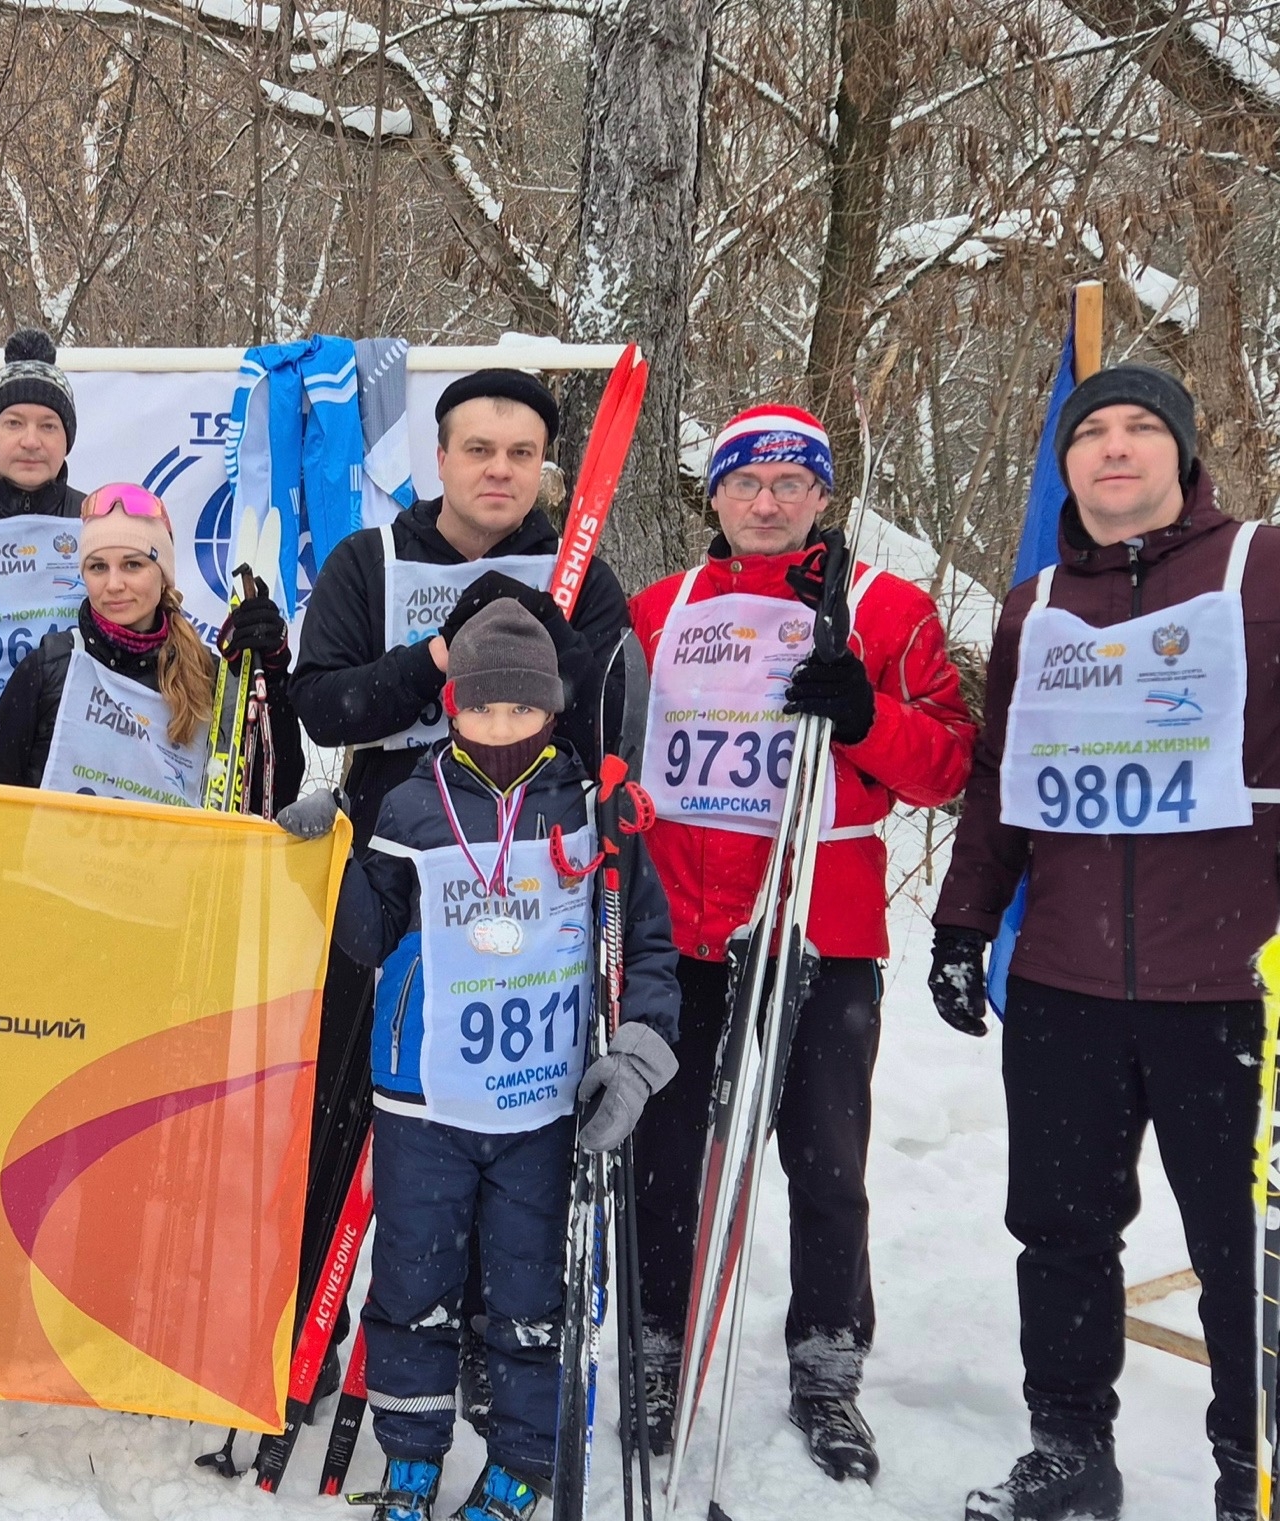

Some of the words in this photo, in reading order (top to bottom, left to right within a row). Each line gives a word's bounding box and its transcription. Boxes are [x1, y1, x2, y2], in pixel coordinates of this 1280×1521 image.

[12, 607, 55, 620] НОРМА
[678, 621, 734, 645] КРОСС
[673, 643, 752, 665] НАЦИИ
[1044, 641, 1097, 668] КРОСС
[1037, 664, 1123, 691] НАЦИИ
[665, 710, 697, 724] СПОРТ
[707, 709, 759, 724] НОРМА
[665, 729, 796, 789] 9736
[1031, 743, 1069, 757] СПОРТ
[1081, 739, 1143, 757] НОРМА
[1145, 736, 1211, 754] ЖИЗНИ
[73, 764, 108, 784] СПОРТ
[116, 777, 161, 801] НОРМА
[1037, 760, 1197, 829] 9804
[680, 796, 770, 813] САМАРСКАЯ
[451, 980, 495, 994] СПОРТ
[508, 970, 556, 989] НОРМА
[460, 984, 581, 1065] 9811
[486, 1061, 568, 1091] САМАРСКАЯ
[497, 1085, 558, 1110] ОБЛАСТЬ
[315, 1223, 357, 1331] ACTIVESONIC
[341, 1418, 356, 1428] 200
